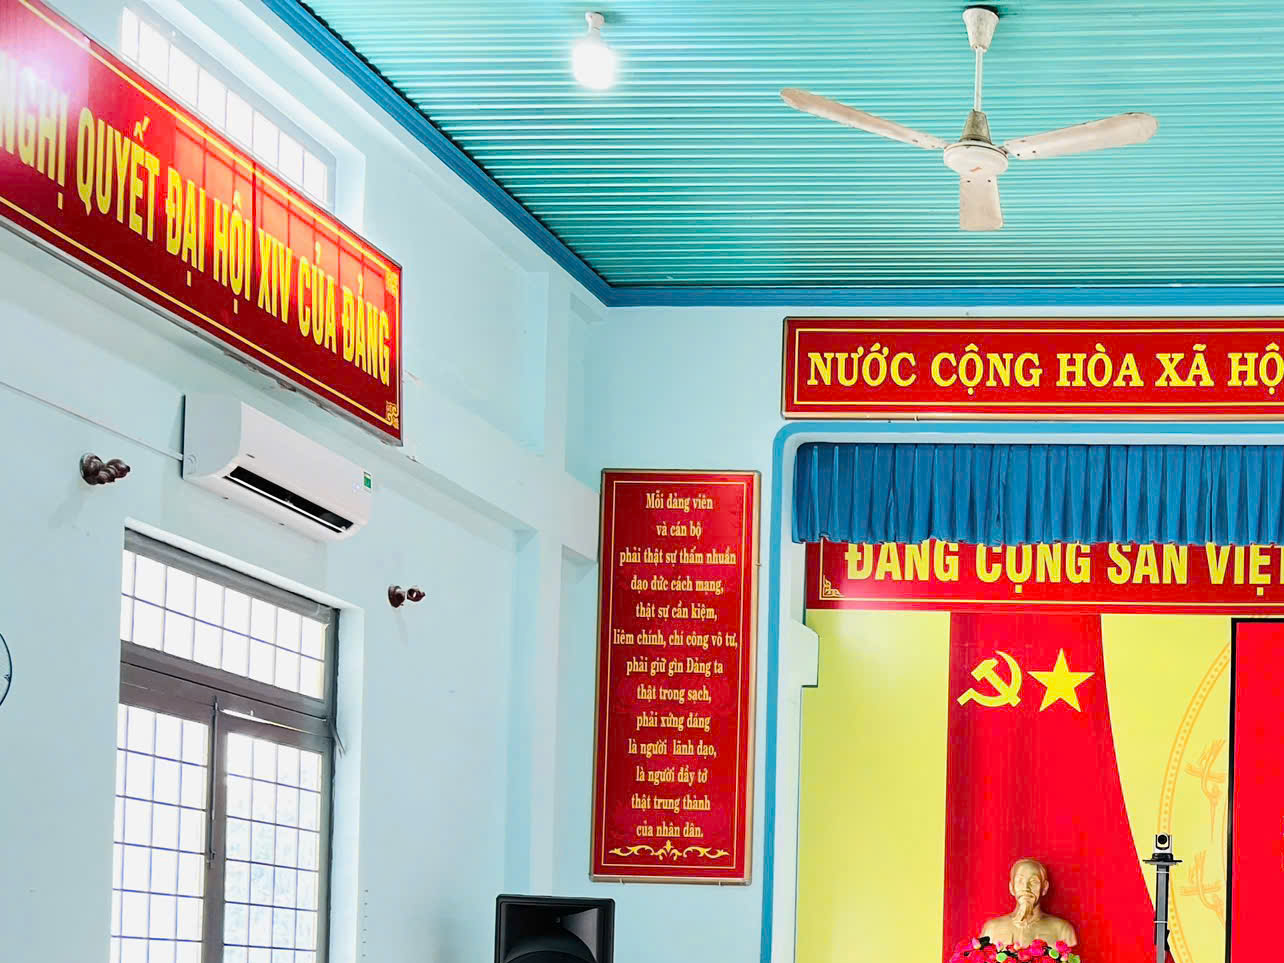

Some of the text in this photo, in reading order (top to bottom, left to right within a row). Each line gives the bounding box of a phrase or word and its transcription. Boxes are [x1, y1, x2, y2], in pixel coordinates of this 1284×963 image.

[76, 107, 160, 242] QUYẾT
[165, 167, 205, 287] ĐẠI
[213, 190, 251, 314] HỘI
[257, 227, 293, 324] XIV
[297, 241, 337, 354] CỦA
[342, 274, 390, 387] ĐẢNG
[807, 343, 916, 386] NƯỚC
[932, 344, 1042, 394] CỘNG
[1056, 344, 1144, 386] HÒA
[1155, 344, 1214, 386] XÃ
[667, 493, 690, 512] đảng
[692, 494, 713, 509] viên
[656, 521, 702, 539] và cán bộ
[620, 547, 640, 566] phải
[644, 548, 663, 566] thật
[666, 550, 677, 566] sự
[680, 546, 704, 564] thấm
[631, 575, 648, 593] đạo
[671, 576, 693, 591] cách
[696, 580, 724, 595] mạng,
[636, 602, 655, 620] thật
[658, 605, 669, 621] sự
[691, 603, 717, 621] kiệm,
[614, 629, 634, 644] liêm
[637, 630, 666, 648] chính,
[686, 632, 709, 650] công
[712, 632, 722, 646] vô
[726, 633, 738, 648] tư,
[627, 656, 647, 675] phải
[686, 657, 712, 677] Đảng
[714, 660, 723, 673] ta
[638, 684, 711, 704] thật trong sạch,
[637, 711, 657, 730] phải
[687, 712, 710, 732] đáng
[628, 738, 637, 754] là
[636, 766, 645, 781] là
[632, 794, 650, 811] thật
[654, 796, 680, 813] trung
[637, 820, 703, 837] của nhân dân.
